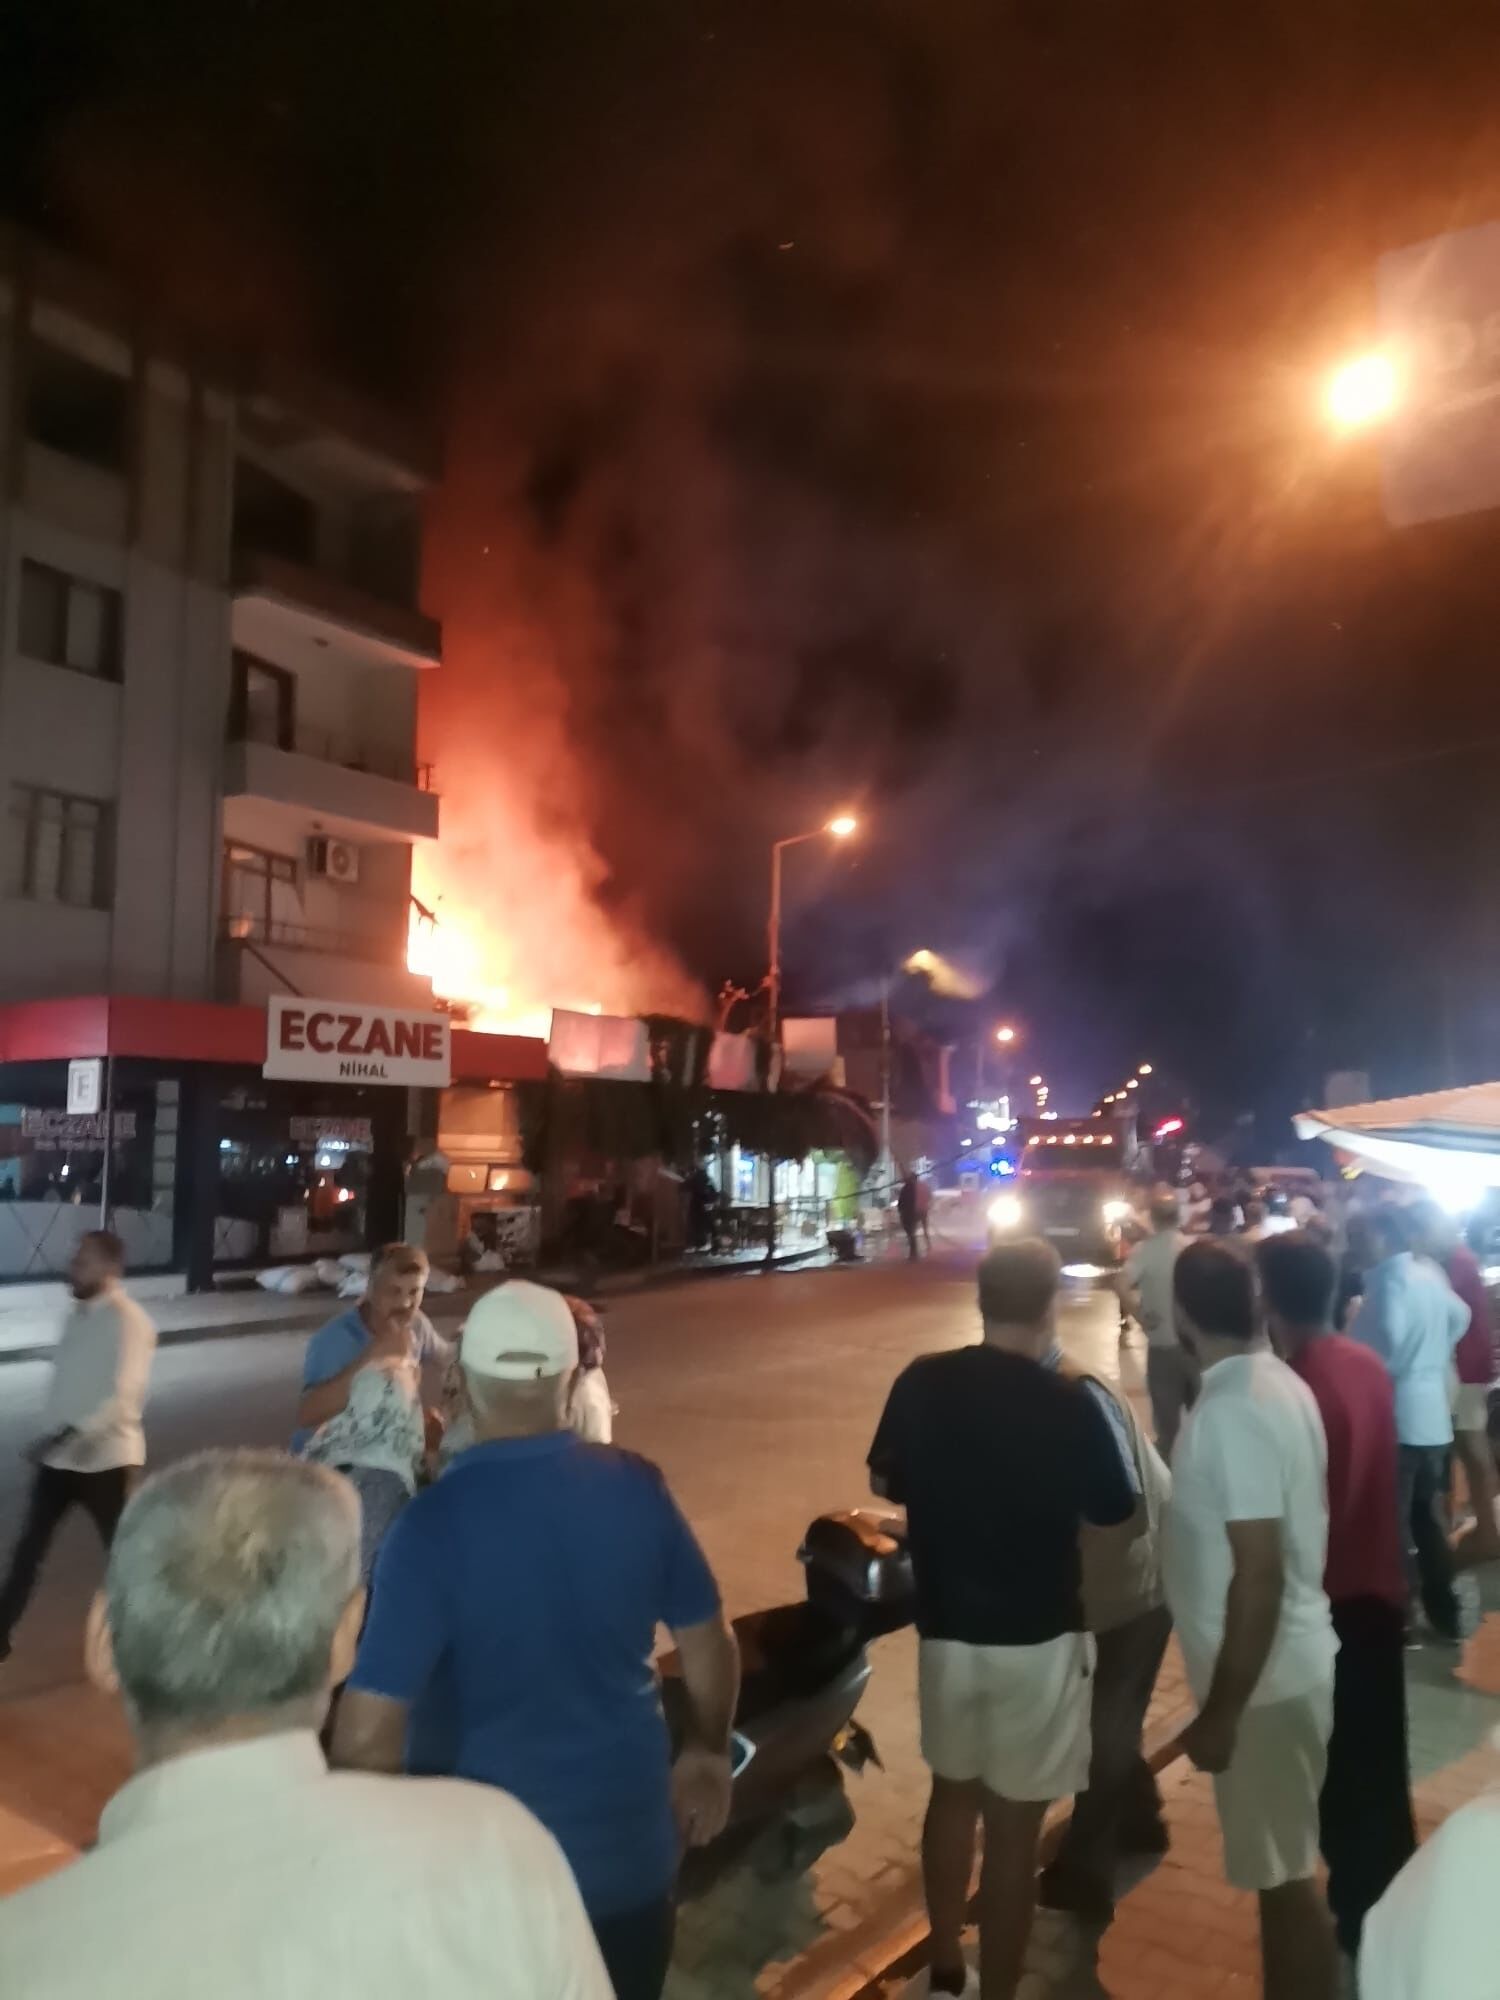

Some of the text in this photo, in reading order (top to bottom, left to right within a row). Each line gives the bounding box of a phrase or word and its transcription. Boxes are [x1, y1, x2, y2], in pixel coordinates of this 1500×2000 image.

[280, 1010, 443, 1060] ECZANE
[339, 1061, 388, 1078] NİHAL
[77, 1073, 90, 1100] E
